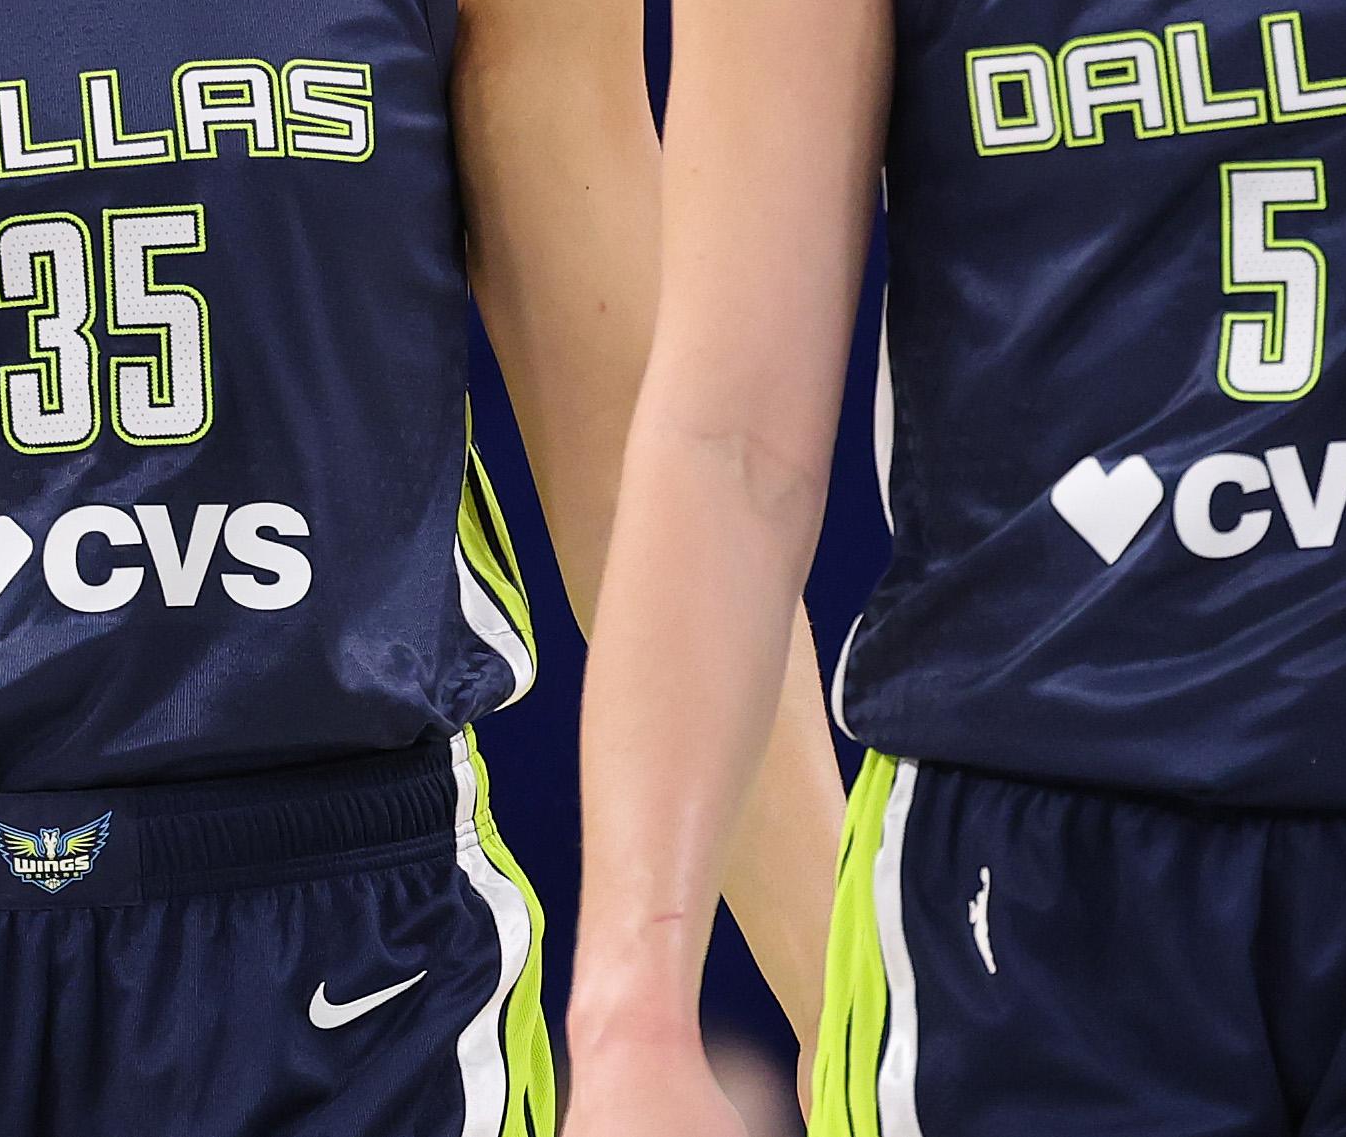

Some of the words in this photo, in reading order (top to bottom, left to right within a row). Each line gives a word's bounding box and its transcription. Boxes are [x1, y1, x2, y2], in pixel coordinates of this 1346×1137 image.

[1216, 158, 1328, 402] 5
[43, 502, 313, 614] CVS
[13, 854, 90, 874] WINGS
